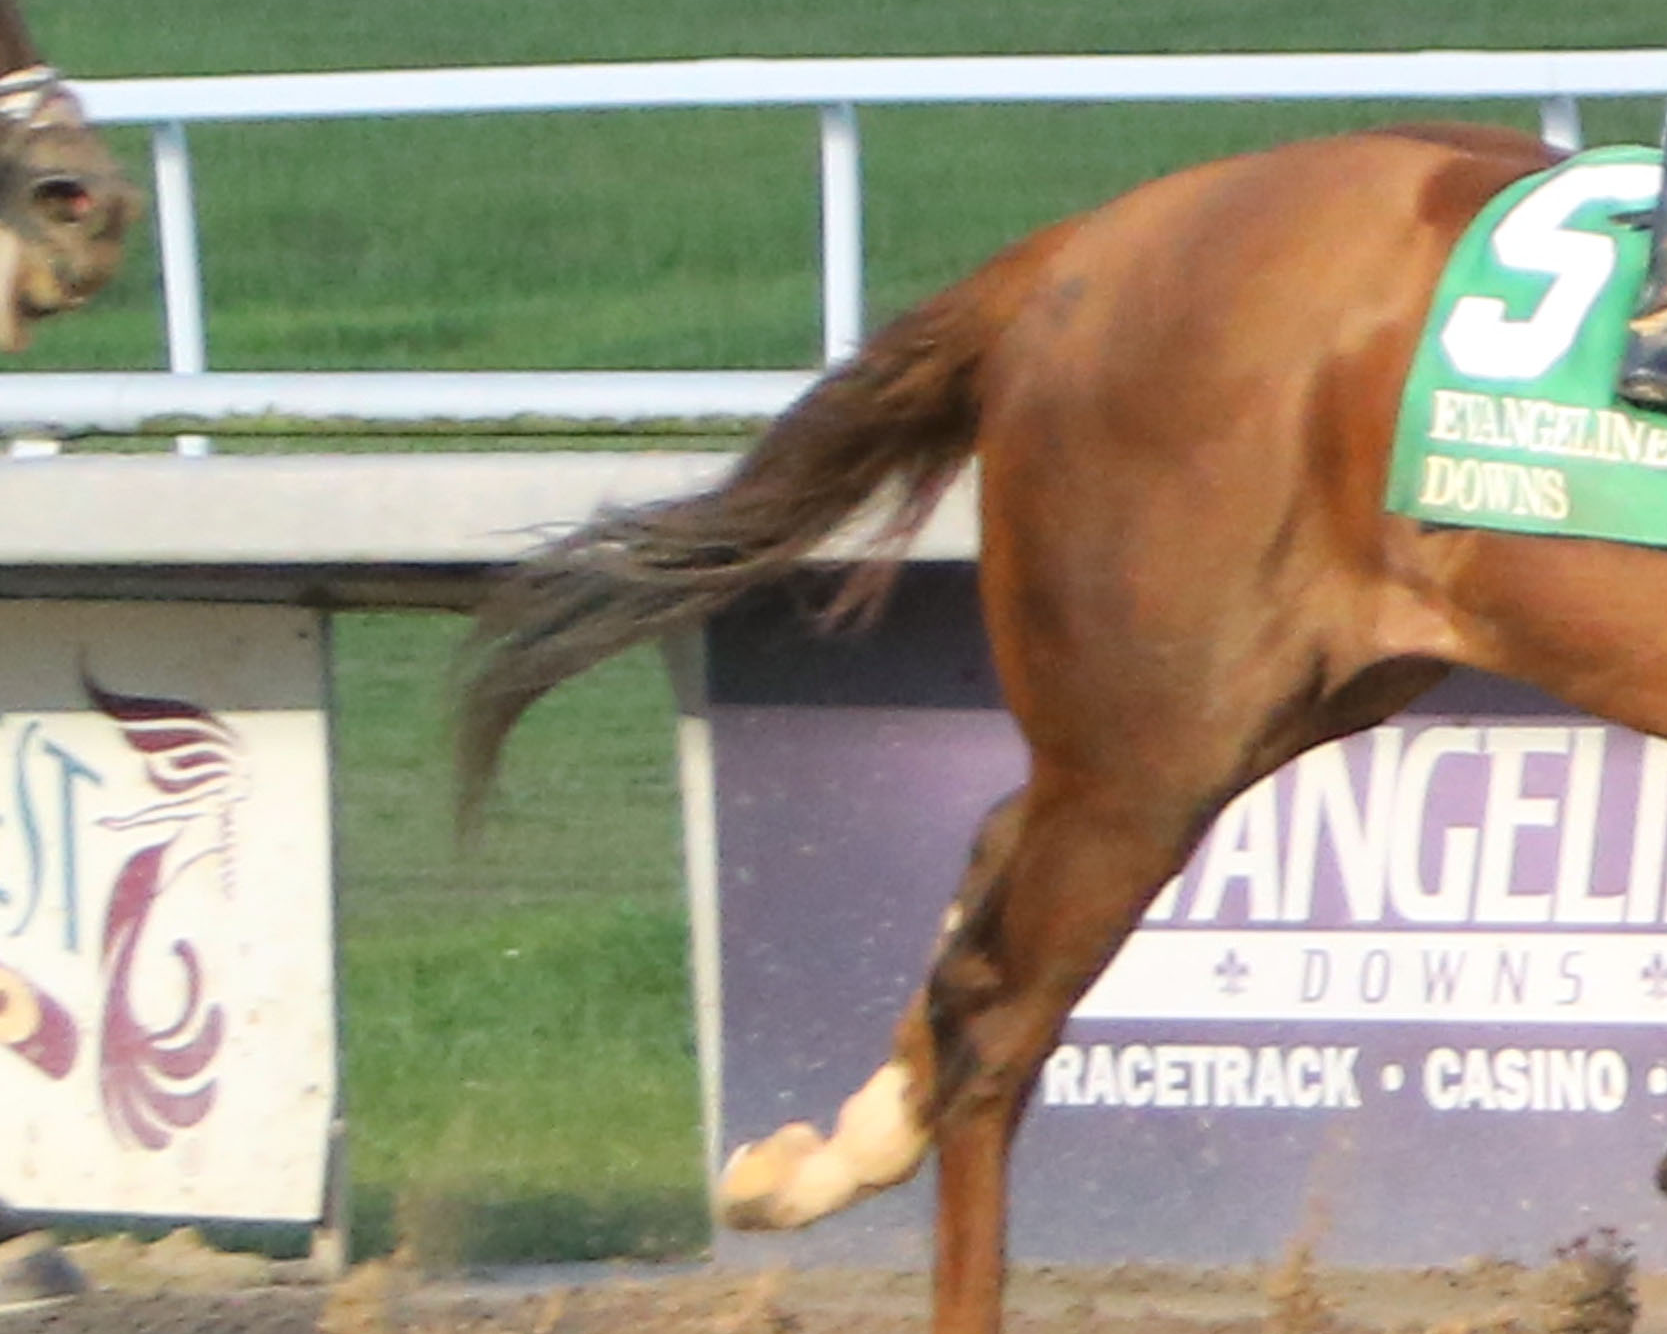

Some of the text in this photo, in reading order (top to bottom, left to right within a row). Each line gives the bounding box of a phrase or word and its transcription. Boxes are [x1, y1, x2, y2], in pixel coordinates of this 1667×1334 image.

[1440, 163, 1664, 380] 5
[1418, 454, 1569, 520] DOWNS
[1299, 946, 1586, 1006] DOWNS
[1043, 1043, 1362, 1108] RACETRACK
[1424, 1047, 1628, 1112] CASINO
